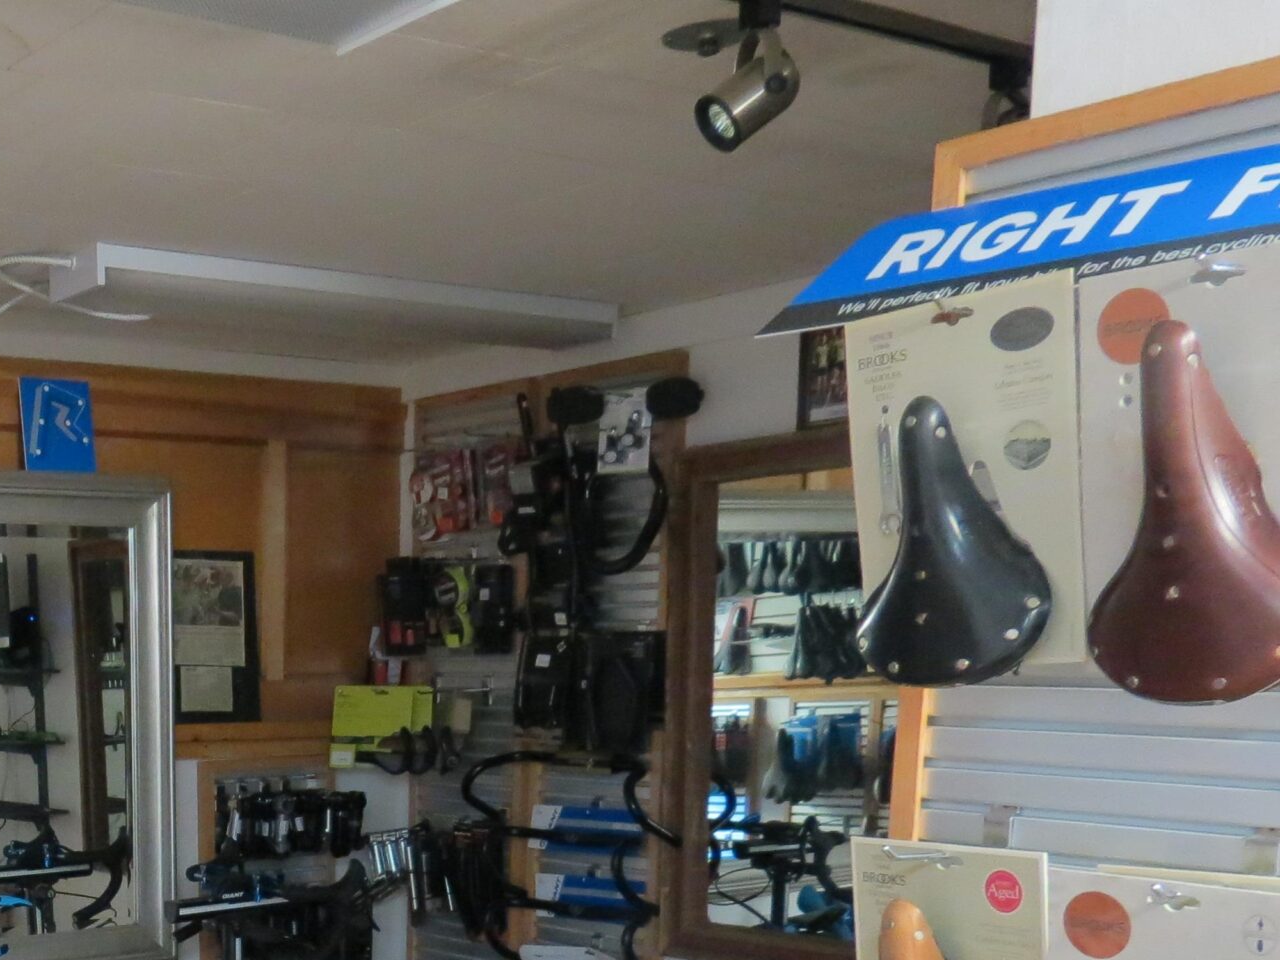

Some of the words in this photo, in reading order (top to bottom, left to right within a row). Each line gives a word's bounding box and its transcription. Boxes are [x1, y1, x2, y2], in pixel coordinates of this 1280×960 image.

[865, 179, 1193, 280] RIGHT
[1207, 162, 1280, 221] F
[837, 297, 879, 316] We'll
[881, 284, 959, 311] perfectly
[960, 281, 980, 296] fit
[1077, 261, 1109, 276] for
[1111, 254, 1147, 270] the
[1150, 244, 1204, 264] best
[987, 884, 1020, 900] Aged
